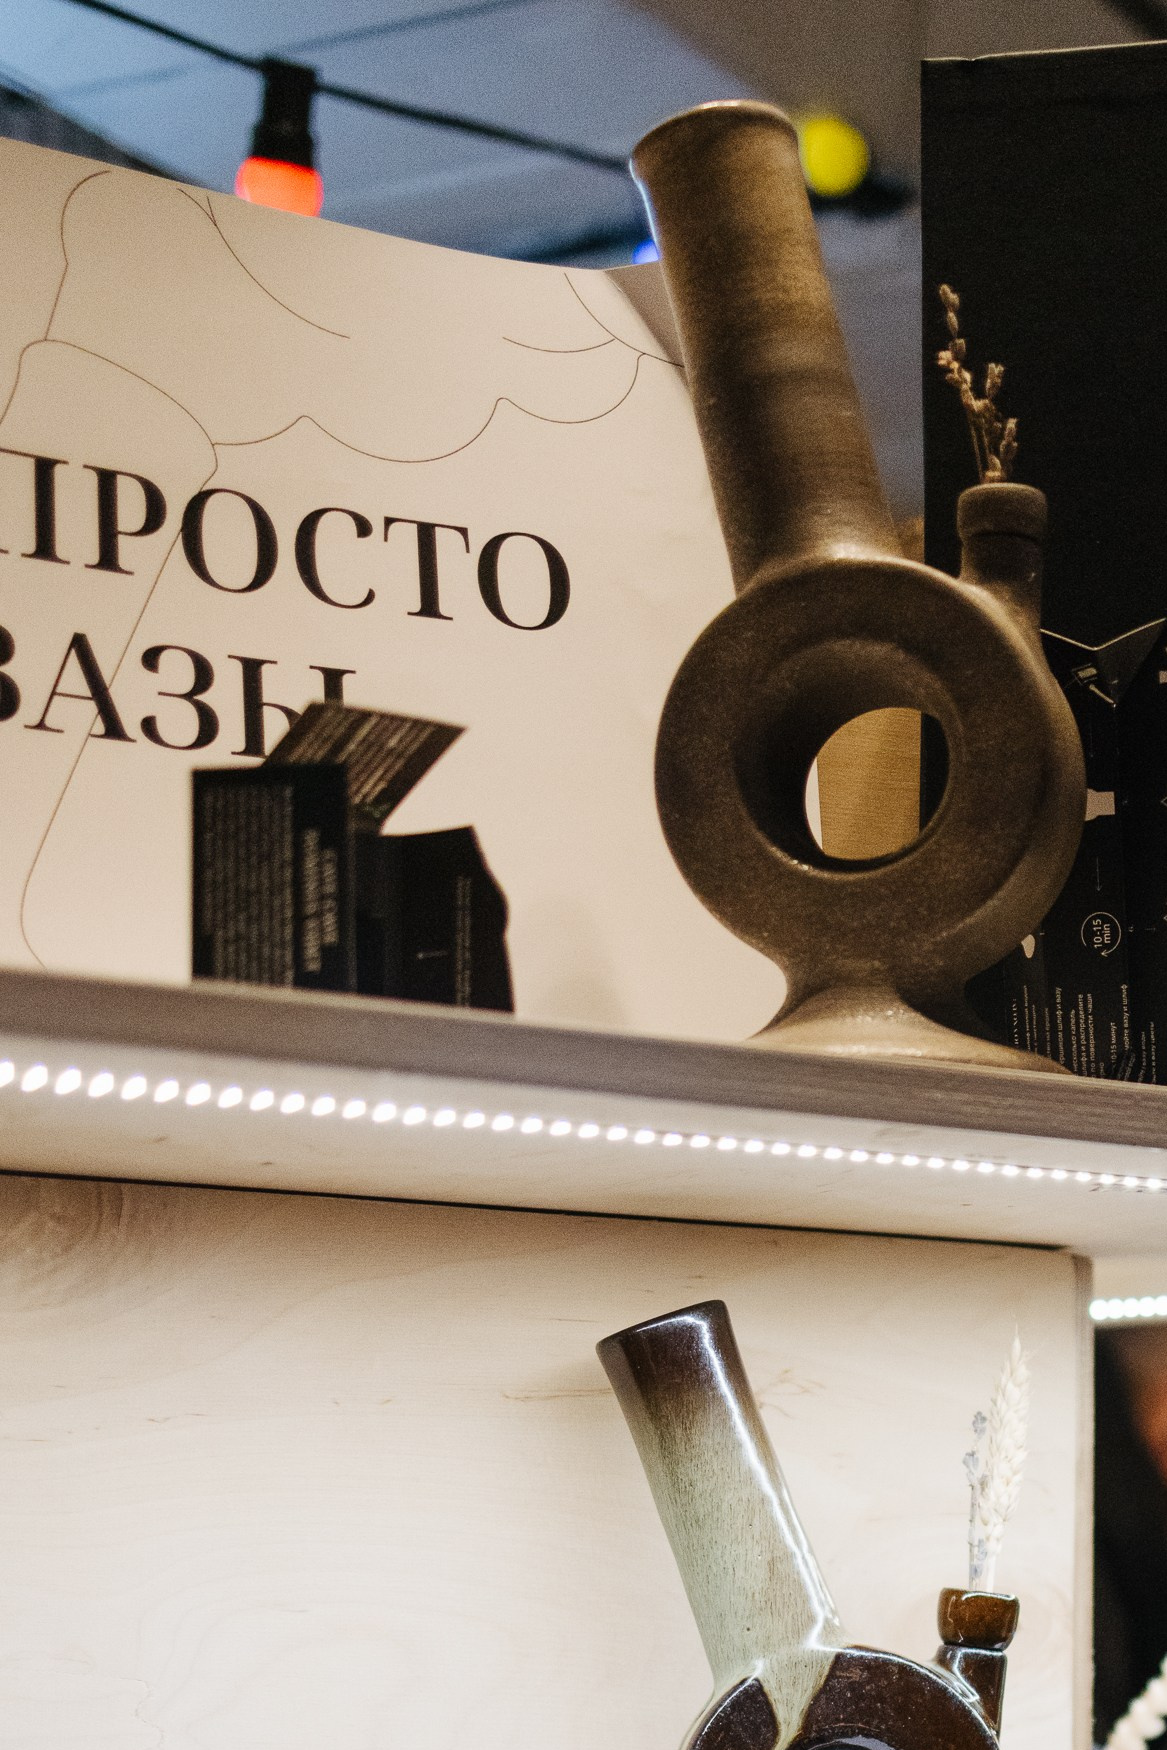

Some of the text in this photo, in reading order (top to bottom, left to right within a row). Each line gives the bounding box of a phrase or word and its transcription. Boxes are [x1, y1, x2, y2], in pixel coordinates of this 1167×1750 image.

[0, 624, 357, 759] АЗЫ
[1092, 919, 1103, 949] 10-15
[1101, 923, 1111, 944] min
